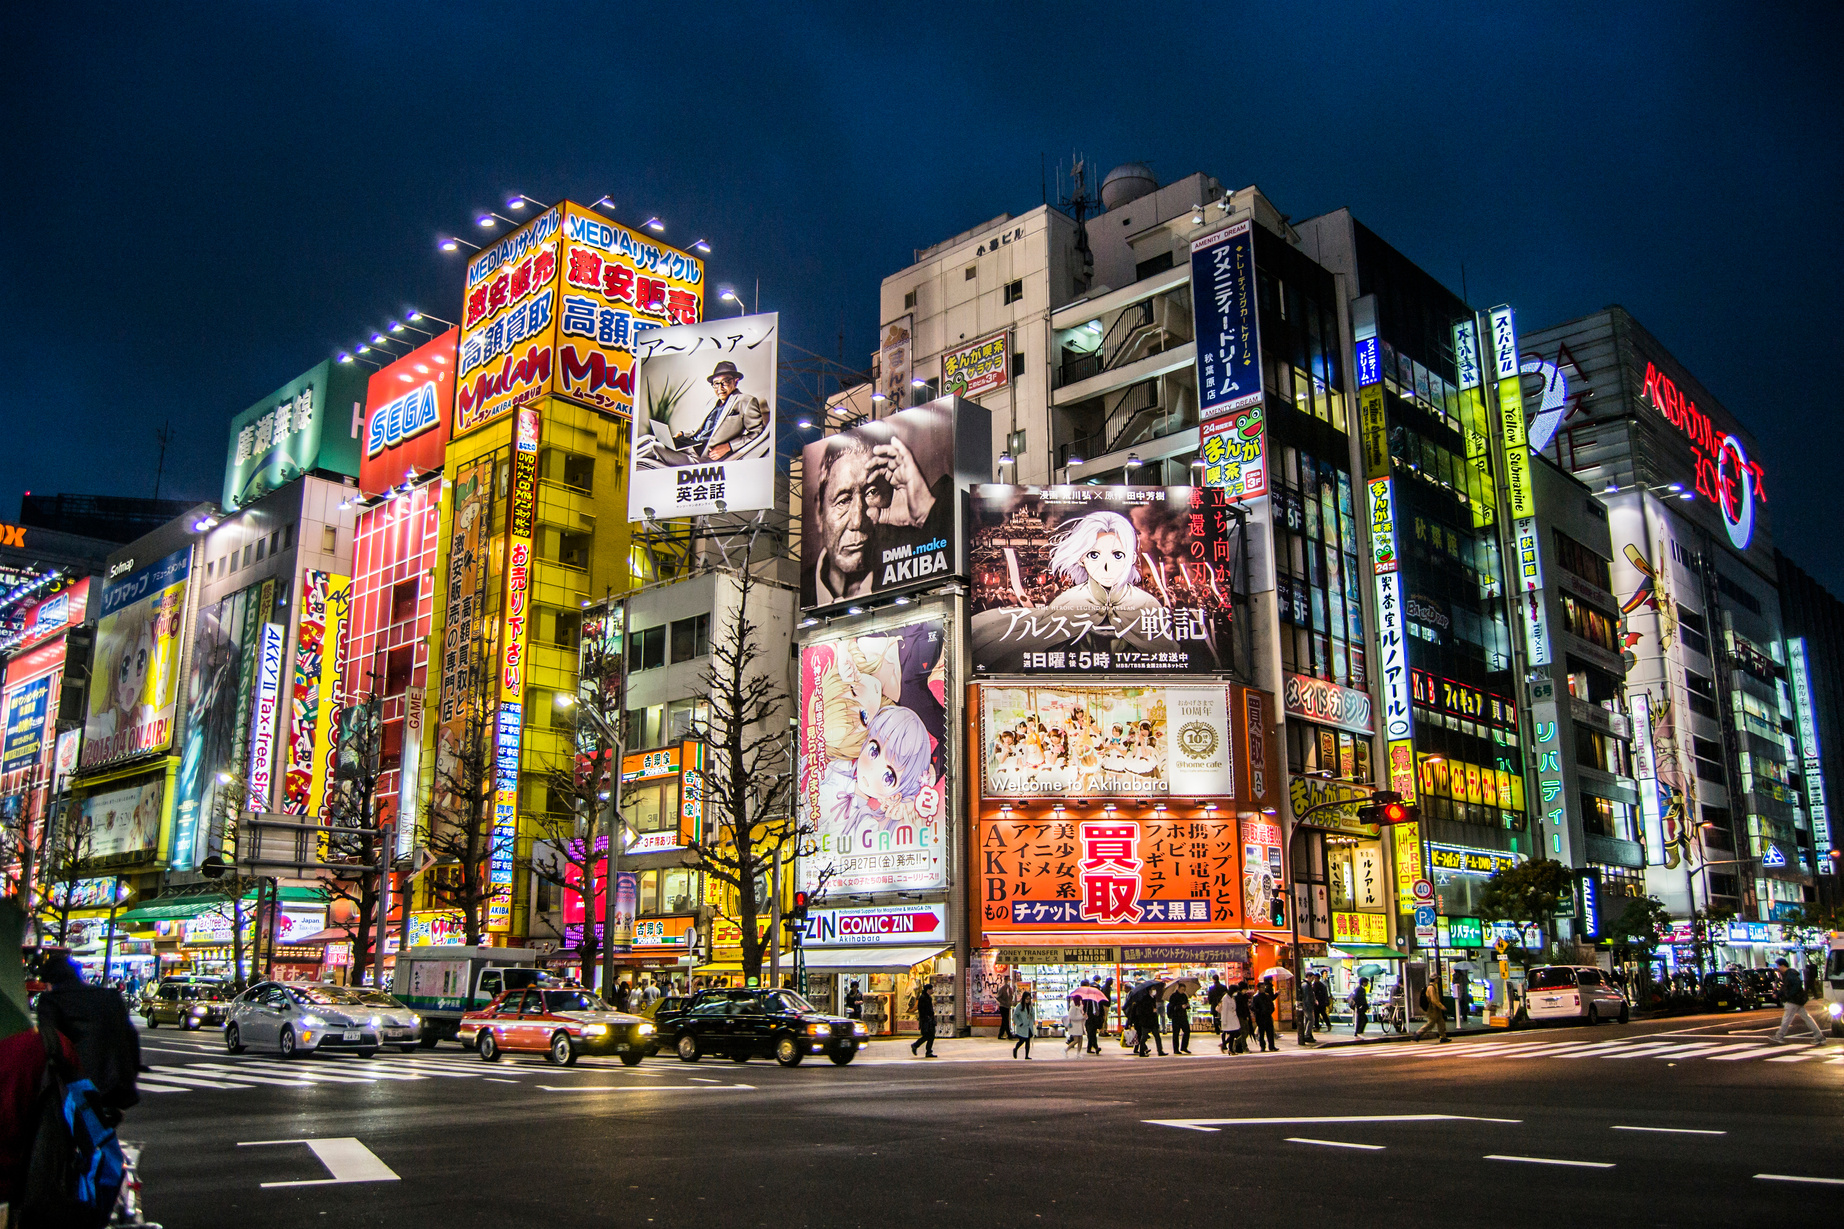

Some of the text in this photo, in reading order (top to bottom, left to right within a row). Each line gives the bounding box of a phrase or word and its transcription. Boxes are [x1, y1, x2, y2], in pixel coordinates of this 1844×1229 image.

[1194, 224, 1246, 249] AMENITY DREAM
[466, 244, 556, 326] 激安販売
[568, 248, 697, 324] 激安販売
[461, 292, 552, 375] 高額買取
[1212, 245, 1240, 395] アメニティードリーム
[945, 339, 1004, 375] まんが喫茶
[1496, 316, 1513, 373] スーパービル
[459, 345, 551, 428] Mulan
[1204, 354, 1216, 400] 秋葉原店
[491, 400, 511, 416] AKIBA
[573, 387, 614, 407] ムーラン
[1204, 396, 1259, 418] AMENITY DREAM
[368, 381, 440, 456] SEGA
[519, 453, 535, 463] DVD
[1204, 435, 1261, 463] まんが
[1505, 408, 1526, 512] Yellow Submarine
[517, 472, 533, 482] ゲーム
[519, 481, 530, 490] CD
[677, 466, 726, 485] DMM
[1206, 461, 1240, 484] 喫茶
[1248, 478, 1261, 488] 3F
[515, 489, 532, 500] アイドル
[515, 499, 532, 509] アニメ
[676, 483, 725, 502] 英会話
[1371, 481, 1388, 523] まんが
[515, 519, 530, 527] ホビー
[1288, 508, 1302, 529] 6F
[1519, 518, 1531, 527] 5F
[110, 559, 134, 578] Sofmap
[882, 550, 948, 585] AKIBA
[105, 572, 149, 610] ソフマップ
[1381, 576, 1396, 628] 喫茶室
[999, 606, 1209, 645] アルスラーン戦記
[1294, 600, 1308, 621] 5F
[442, 534, 465, 723] 激安販売の専門店
[455, 594, 473, 716] 高額買取と
[1115, 653, 1188, 663] TVアニメ放送中
[1382, 631, 1406, 717] ルノアール
[255, 627, 281, 769] AKKY Tax-free
[409, 693, 422, 729] GAME
[1182, 707, 1212, 716] 10周年
[1286, 680, 1370, 726] メイドカジノ
[1444, 684, 1483, 716] フィギュア
[500, 735, 518, 745] DVD
[1187, 734, 1203, 744] 10
[1248, 696, 1264, 769] 買取
[1634, 715, 1645, 754] @home
[1176, 761, 1222, 769] @home cafe
[1390, 745, 1413, 800] 免税
[991, 777, 1168, 792] Welcome to Akihabara
[1255, 773, 1262, 793] 入口
[1536, 721, 1563, 852] リバティー
[1011, 824, 1033, 897] アイドル
[1033, 824, 1054, 877] アニメ
[1053, 823, 1077, 898] 美少女系
[1145, 825, 1166, 899] フィギュア
[1167, 824, 1186, 877] ホビー
[1188, 823, 1211, 898] 携帯電話
[1080, 822, 1145, 923] 買取
[1211, 823, 1234, 922] アップルとか
[1364, 859, 1375, 904] ルノアール
[1418, 885, 1428, 894] 40
[491, 906, 509, 915] AKIBA
[1014, 902, 1208, 922] チケット 大黒屋
[1419, 911, 1427, 924] P
[1583, 878, 1595, 935] GALLERIA
[805, 911, 836, 942] ZIN
[839, 935, 881, 943] Akihabara
[840, 915, 914, 933] COMIC ZIN
[1337, 914, 1359, 935] 免税
[1451, 925, 1480, 939] リバティー
